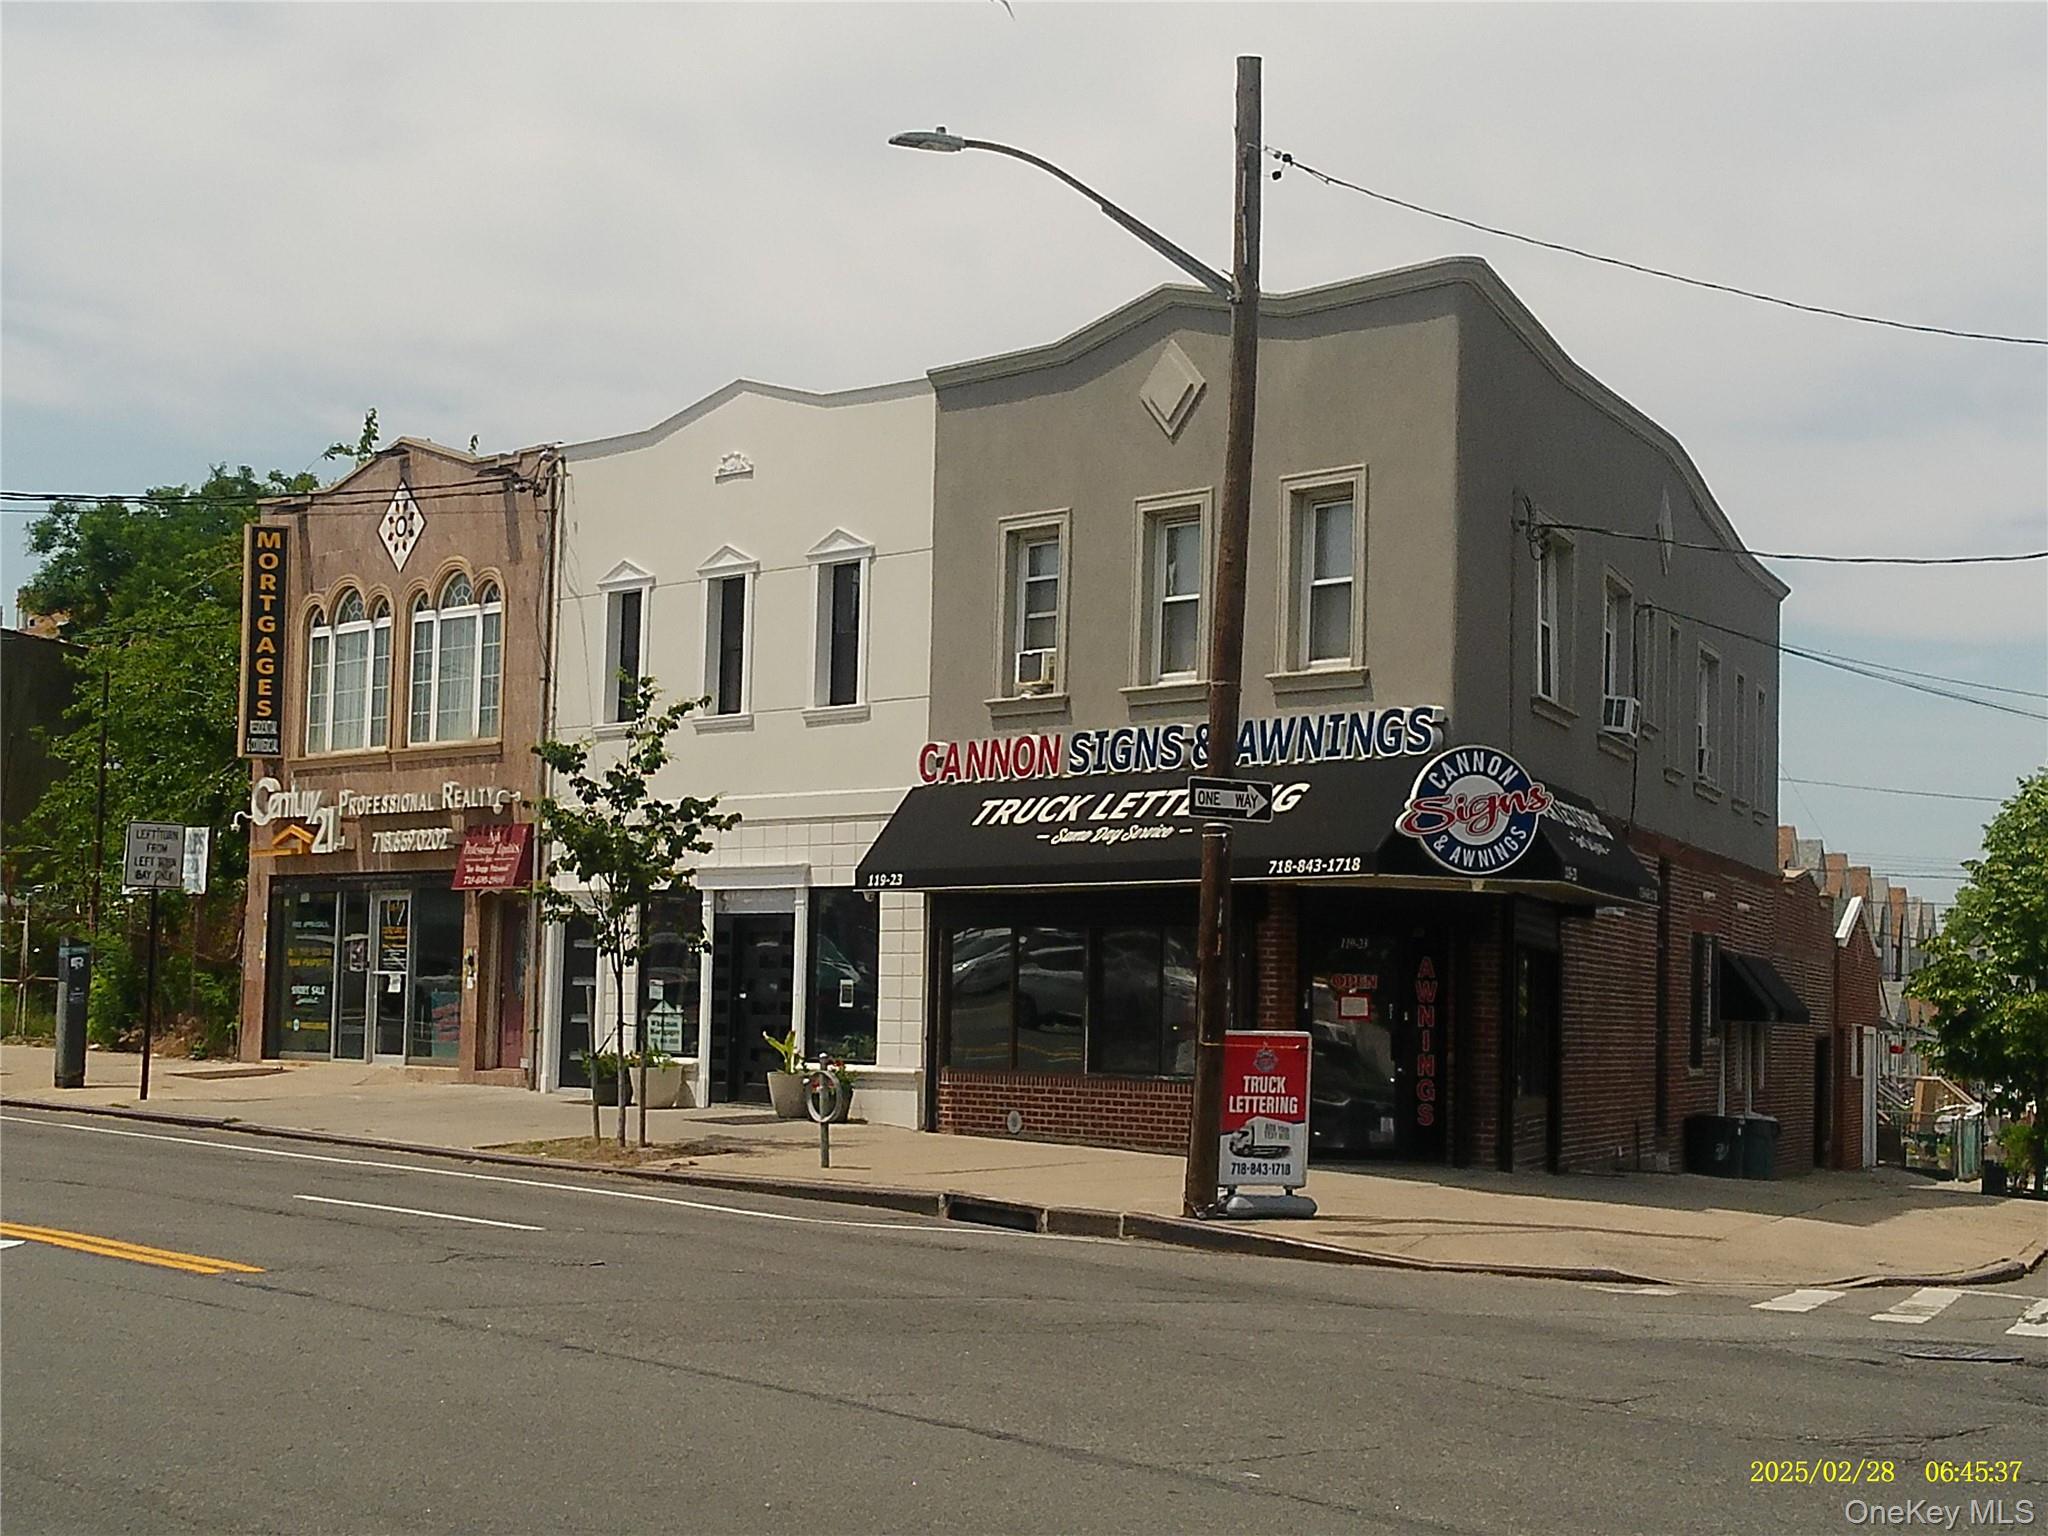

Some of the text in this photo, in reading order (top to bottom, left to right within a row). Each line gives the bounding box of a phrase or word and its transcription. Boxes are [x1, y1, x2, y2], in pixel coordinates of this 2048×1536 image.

[255, 531, 281, 717] MORTGAGES
[918, 734, 1062, 784] CANNON
[1067, 725, 1184, 775] SIGNS
[1235, 706, 1435, 767] AWNINGS
[1427, 750, 1520, 790] CANNON
[971, 794, 1091, 826] TRUCK
[1198, 790, 1259, 809] ONE WAY
[1399, 783, 1553, 836] Signs
[252, 777, 337, 854] Century 21
[1050, 824, 1175, 845] Same Day Service
[1433, 825, 1527, 869] & AWNINGS
[1268, 857, 1361, 874] 718-843-1718
[867, 873, 904, 887] 119-23
[1330, 973, 1378, 990] OPEN
[1415, 956, 1438, 1126] AWNINGS
[1243, 1075, 1286, 1093] TRUCK
[1229, 1096, 1298, 1114] LETTERING
[1231, 1162, 1291, 1176] 718-843-1718
